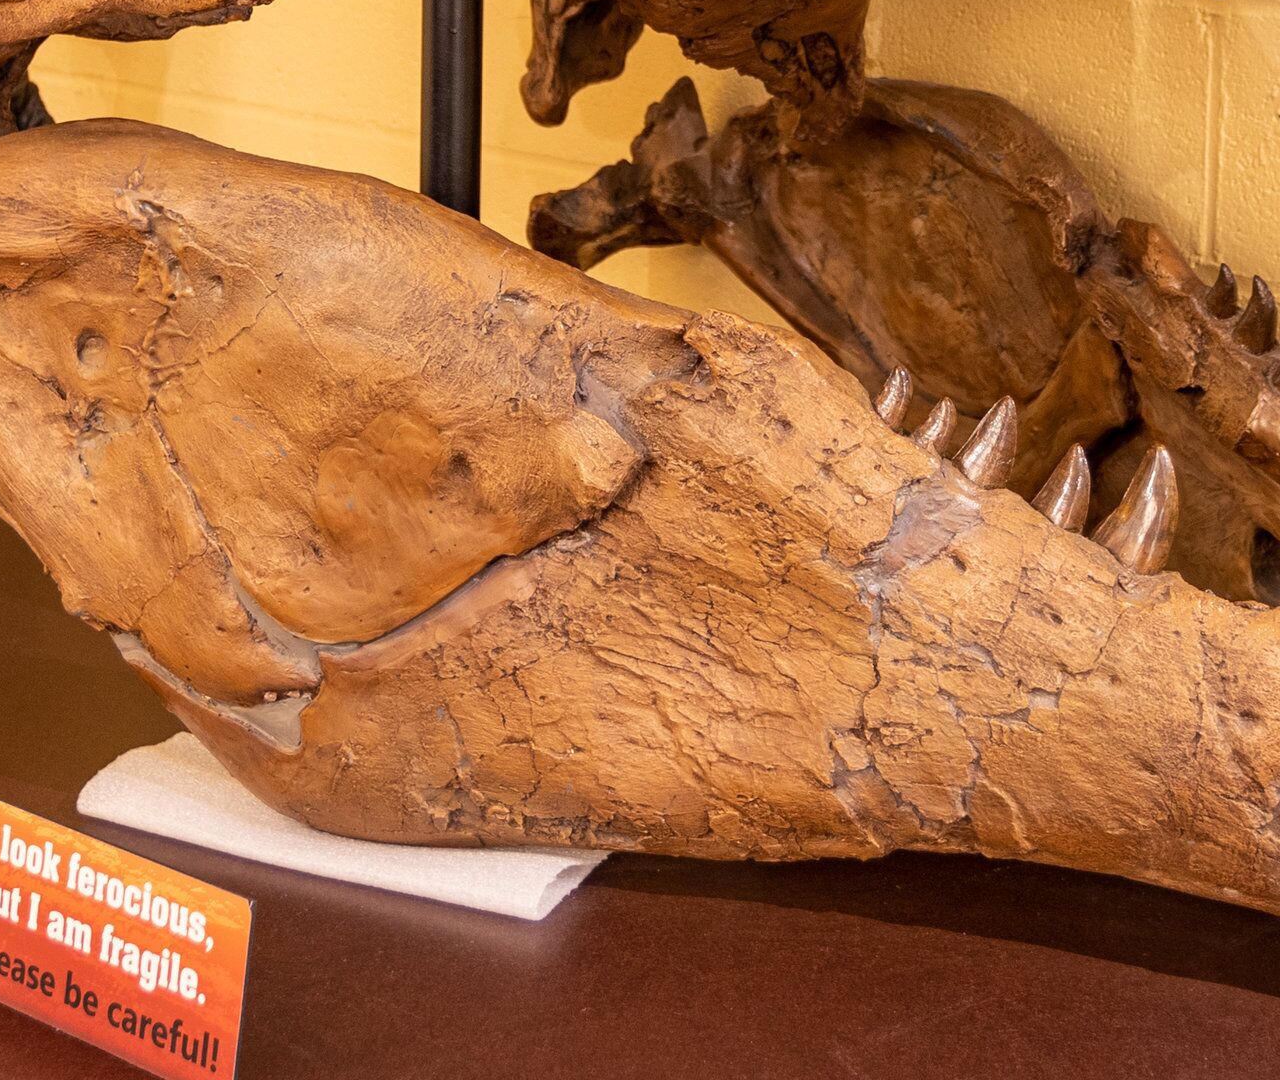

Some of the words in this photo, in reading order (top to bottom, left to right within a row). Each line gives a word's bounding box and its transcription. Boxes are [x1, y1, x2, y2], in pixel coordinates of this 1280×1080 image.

[0, 824, 61, 883] look
[66, 851, 214, 953] ferocious,
[26, 892, 41, 931] I
[46, 909, 92, 954] am
[98, 924, 206, 1006] fragile.
[63, 971, 99, 1017] be
[107, 1002, 220, 1073] careful!
